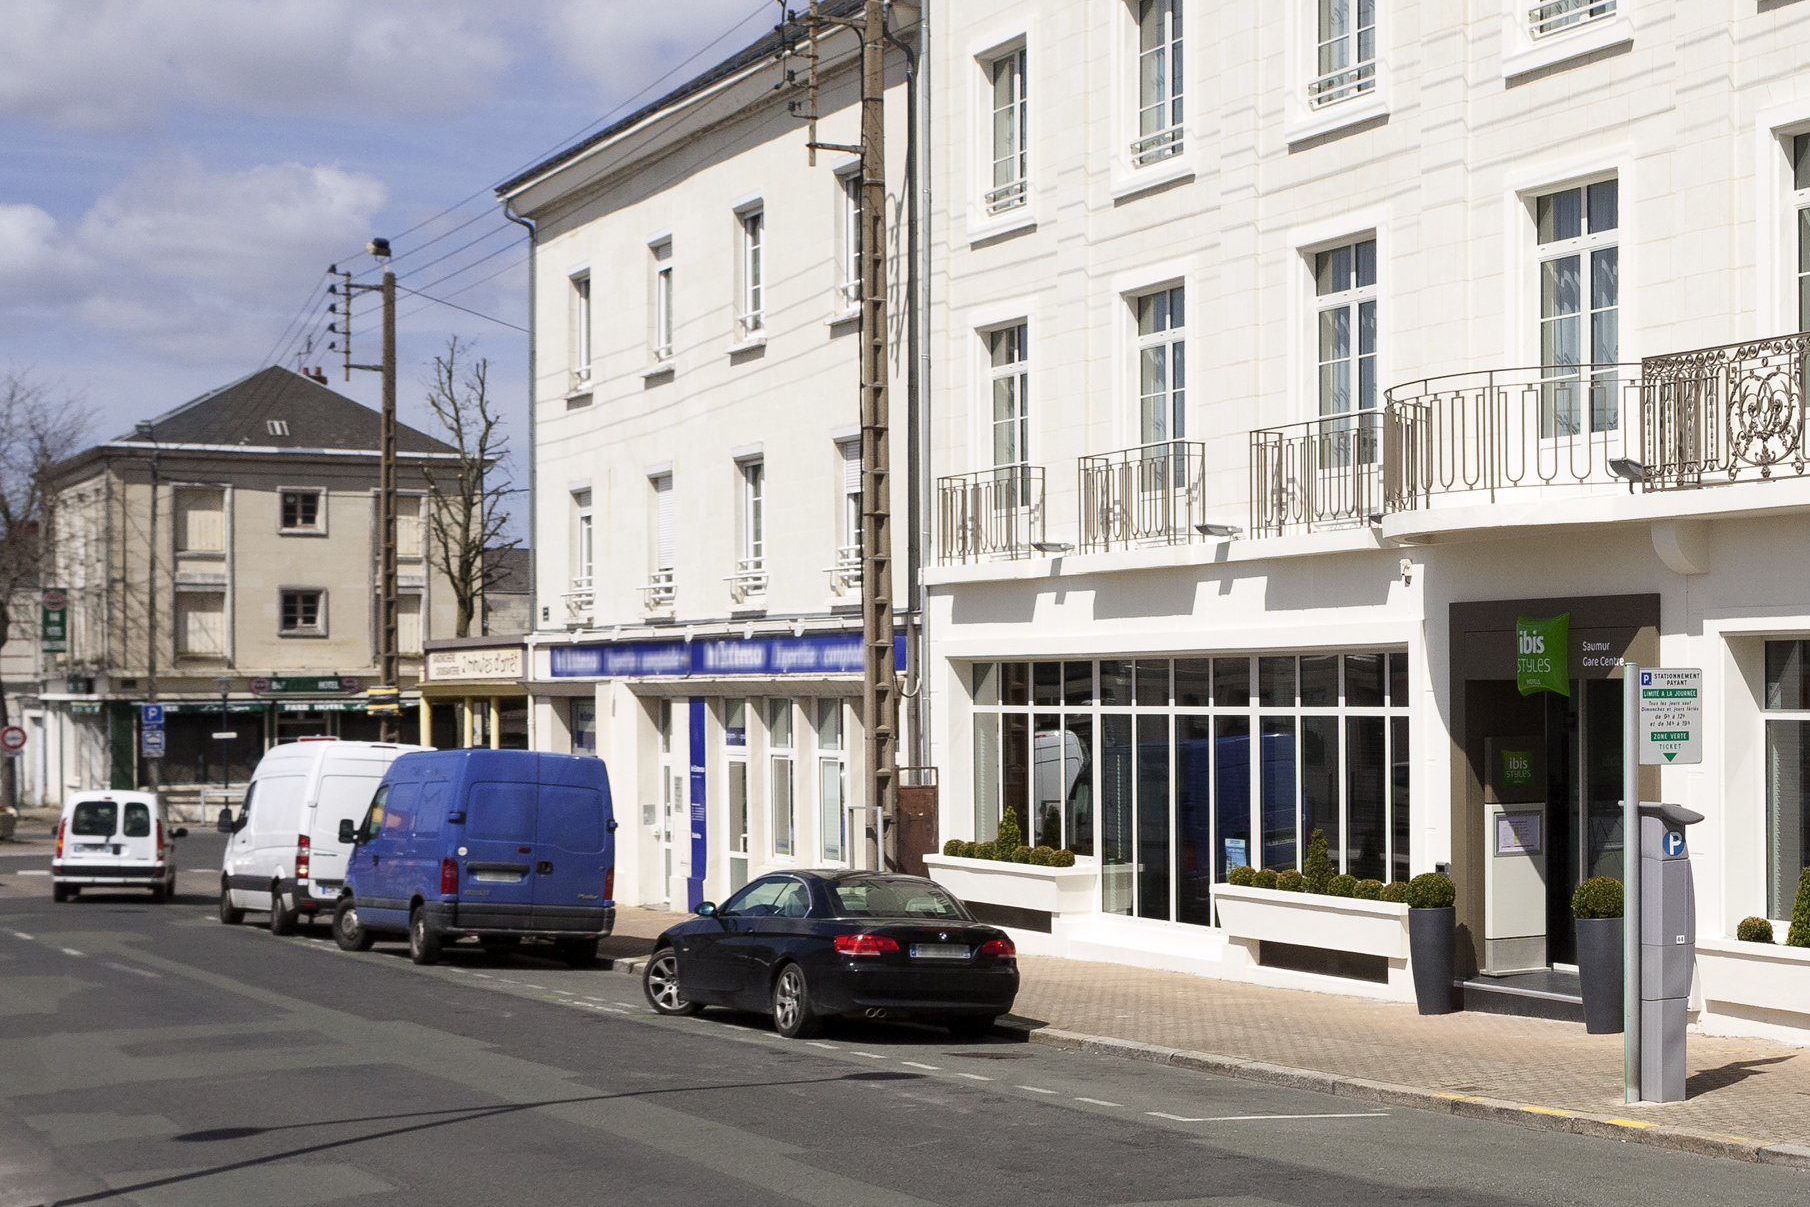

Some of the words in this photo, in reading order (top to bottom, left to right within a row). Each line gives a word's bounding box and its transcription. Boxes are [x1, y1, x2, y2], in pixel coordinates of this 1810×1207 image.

[1519, 630, 1545, 654] ibis
[1582, 641, 1610, 651] Saumur
[1582, 656, 1599, 666] Gare
[1600, 656, 1625, 666] Centre
[1509, 757, 1528, 770] ibis
